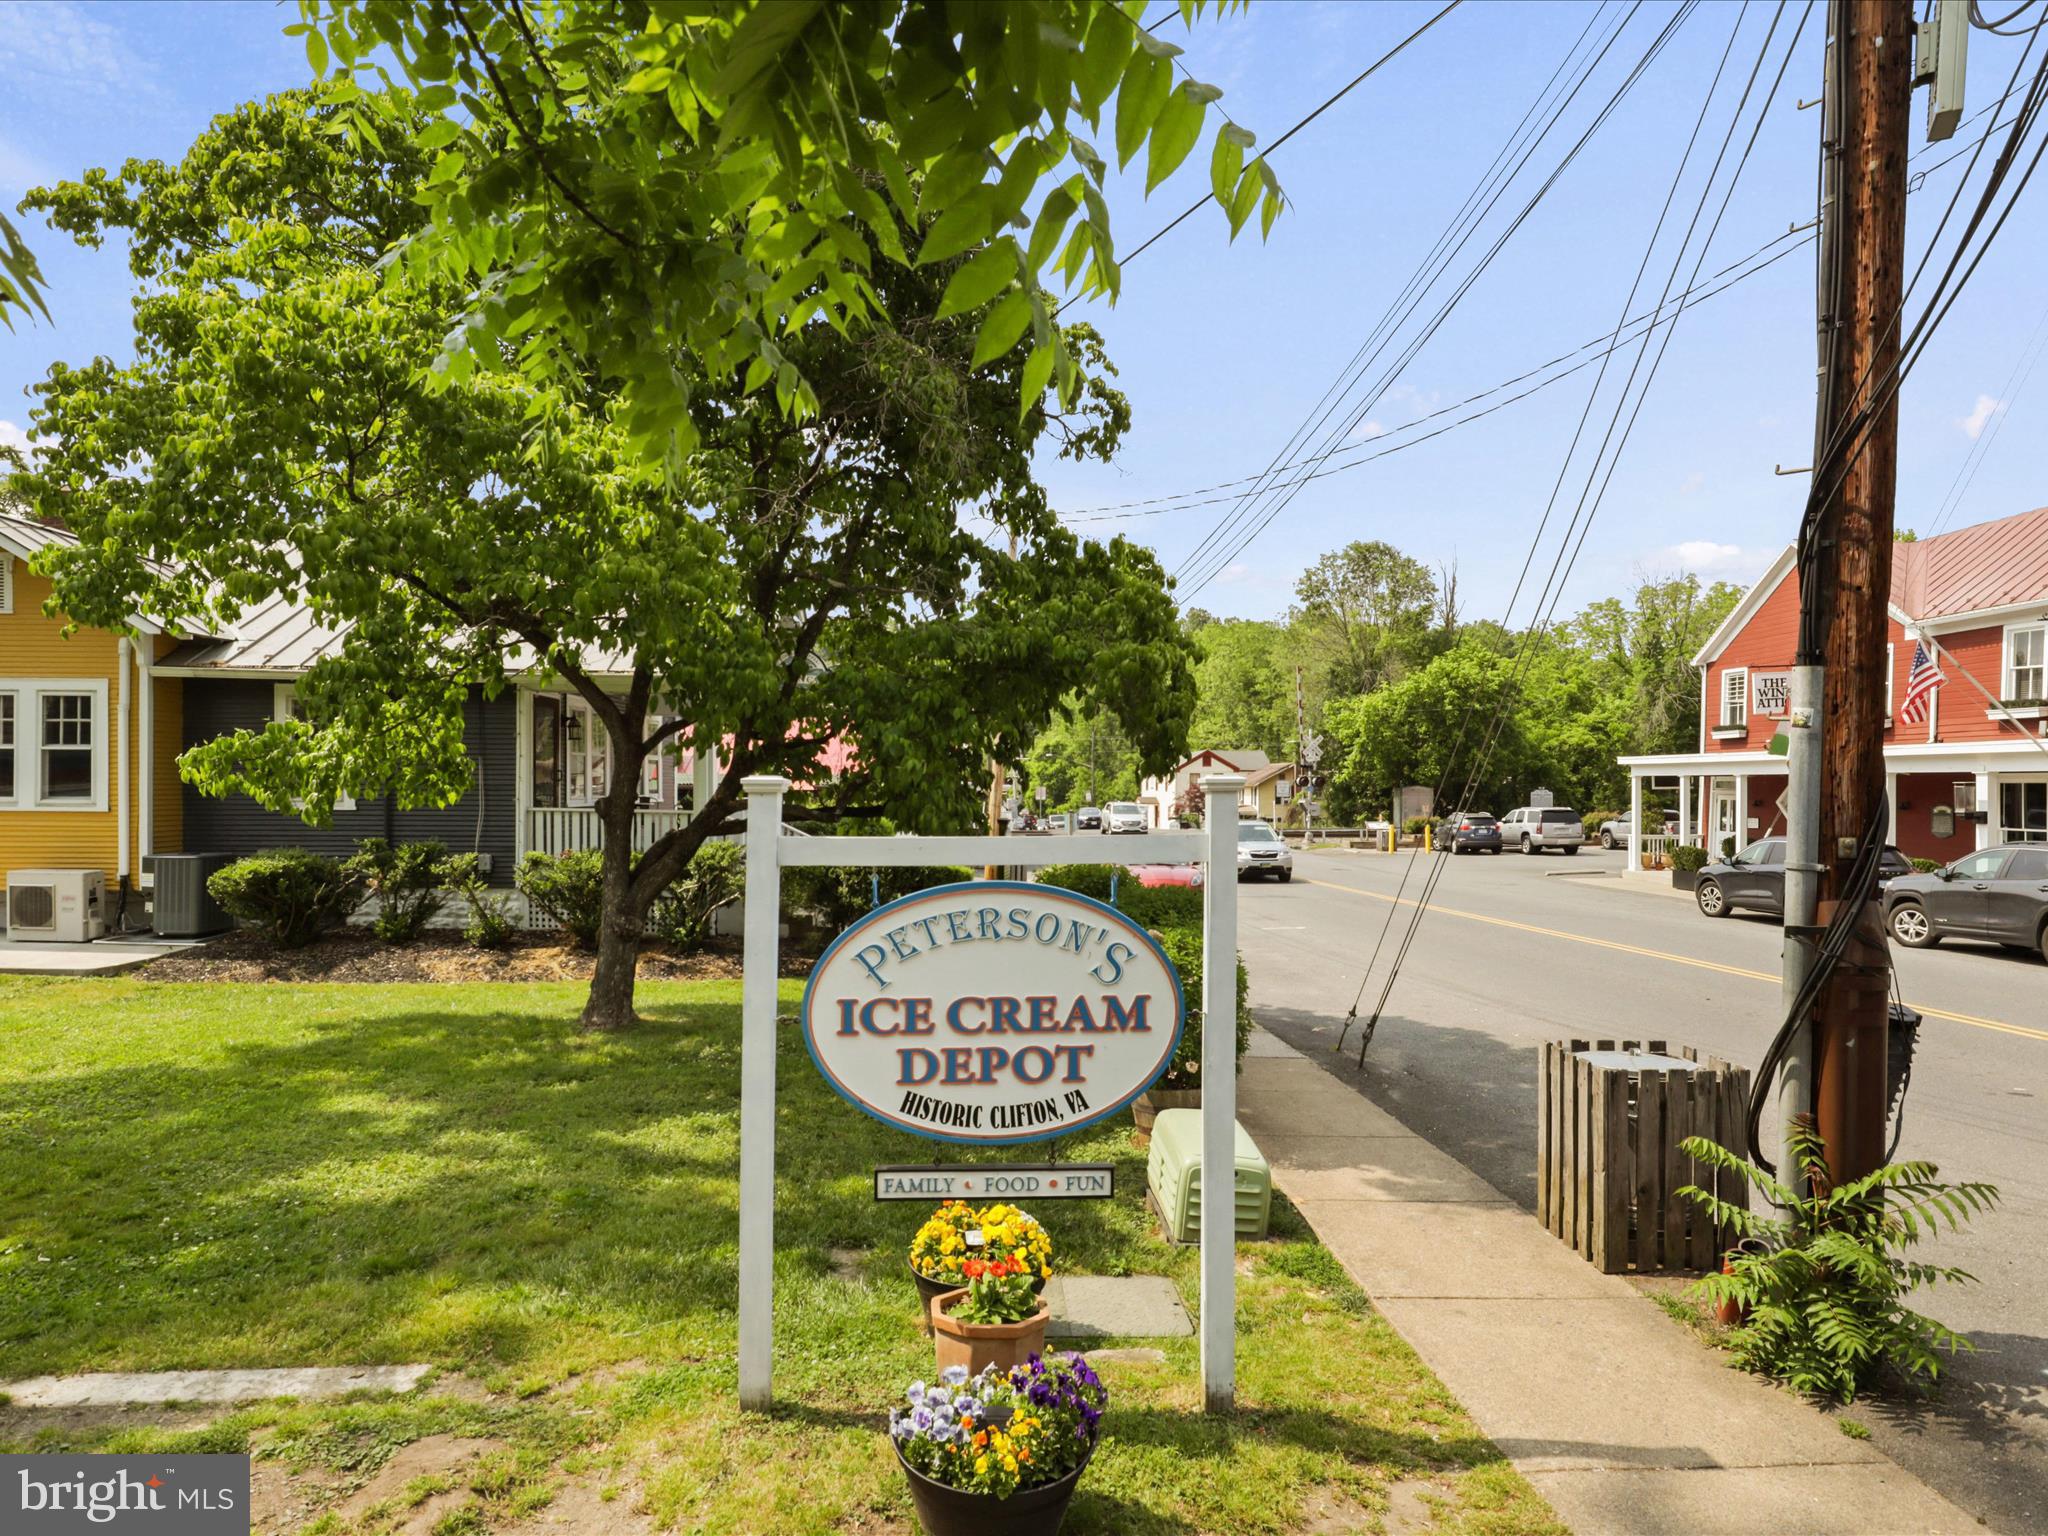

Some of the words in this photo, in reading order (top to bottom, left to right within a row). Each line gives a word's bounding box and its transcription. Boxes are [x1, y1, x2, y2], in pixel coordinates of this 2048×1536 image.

[1757, 687, 1788, 698] WIN
[1757, 698, 1787, 709] ATTI
[851, 906, 1137, 990] PETERSON'S
[836, 998, 936, 1036] ICE
[946, 994, 1152, 1034] CREAM
[896, 1044, 1094, 1086] DEPOT
[899, 1090, 983, 1129] HISTORIC
[989, 1098, 1065, 1129] CLIFTON,
[1063, 1088, 1090, 1114] VA
[883, 1177, 956, 1194] FAMILY
[984, 1176, 1040, 1192] FOOD
[1065, 1175, 1106, 1191] FUN
